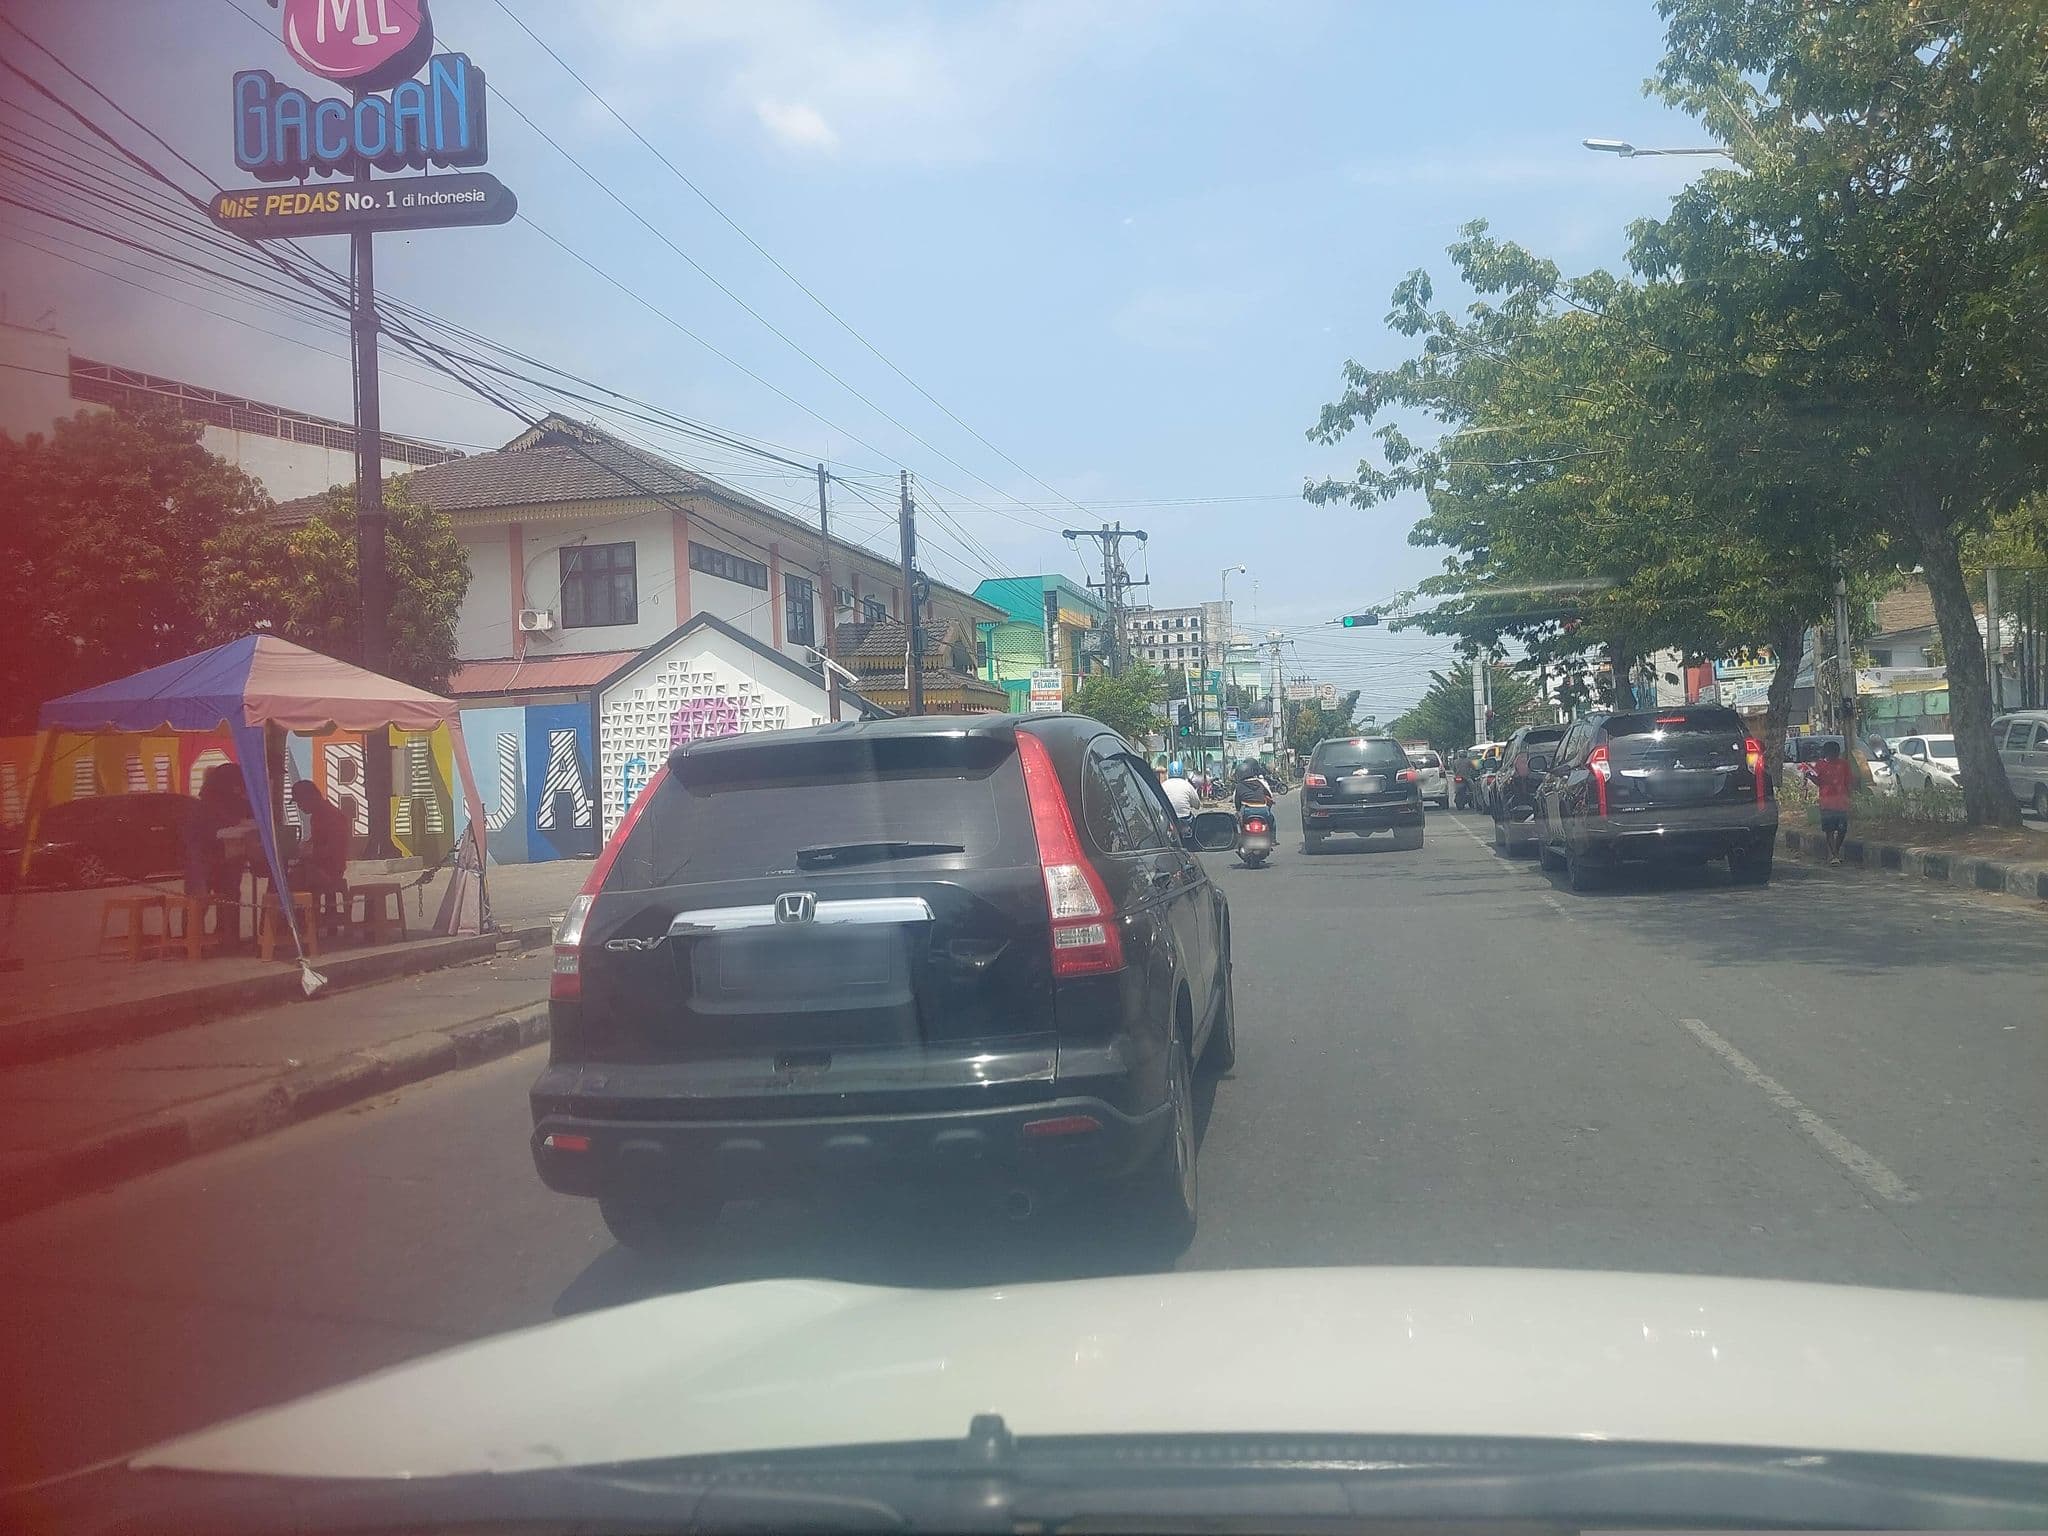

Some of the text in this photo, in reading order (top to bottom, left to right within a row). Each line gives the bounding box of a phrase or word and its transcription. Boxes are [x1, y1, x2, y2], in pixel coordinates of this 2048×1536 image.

[236, 56, 469, 165] GACOAN
[265, 191, 341, 216] PEDAS
[345, 193, 380, 210] No.
[386, 190, 397, 209] 1
[402, 193, 415, 206] di
[417, 188, 486, 205] Indonesia
